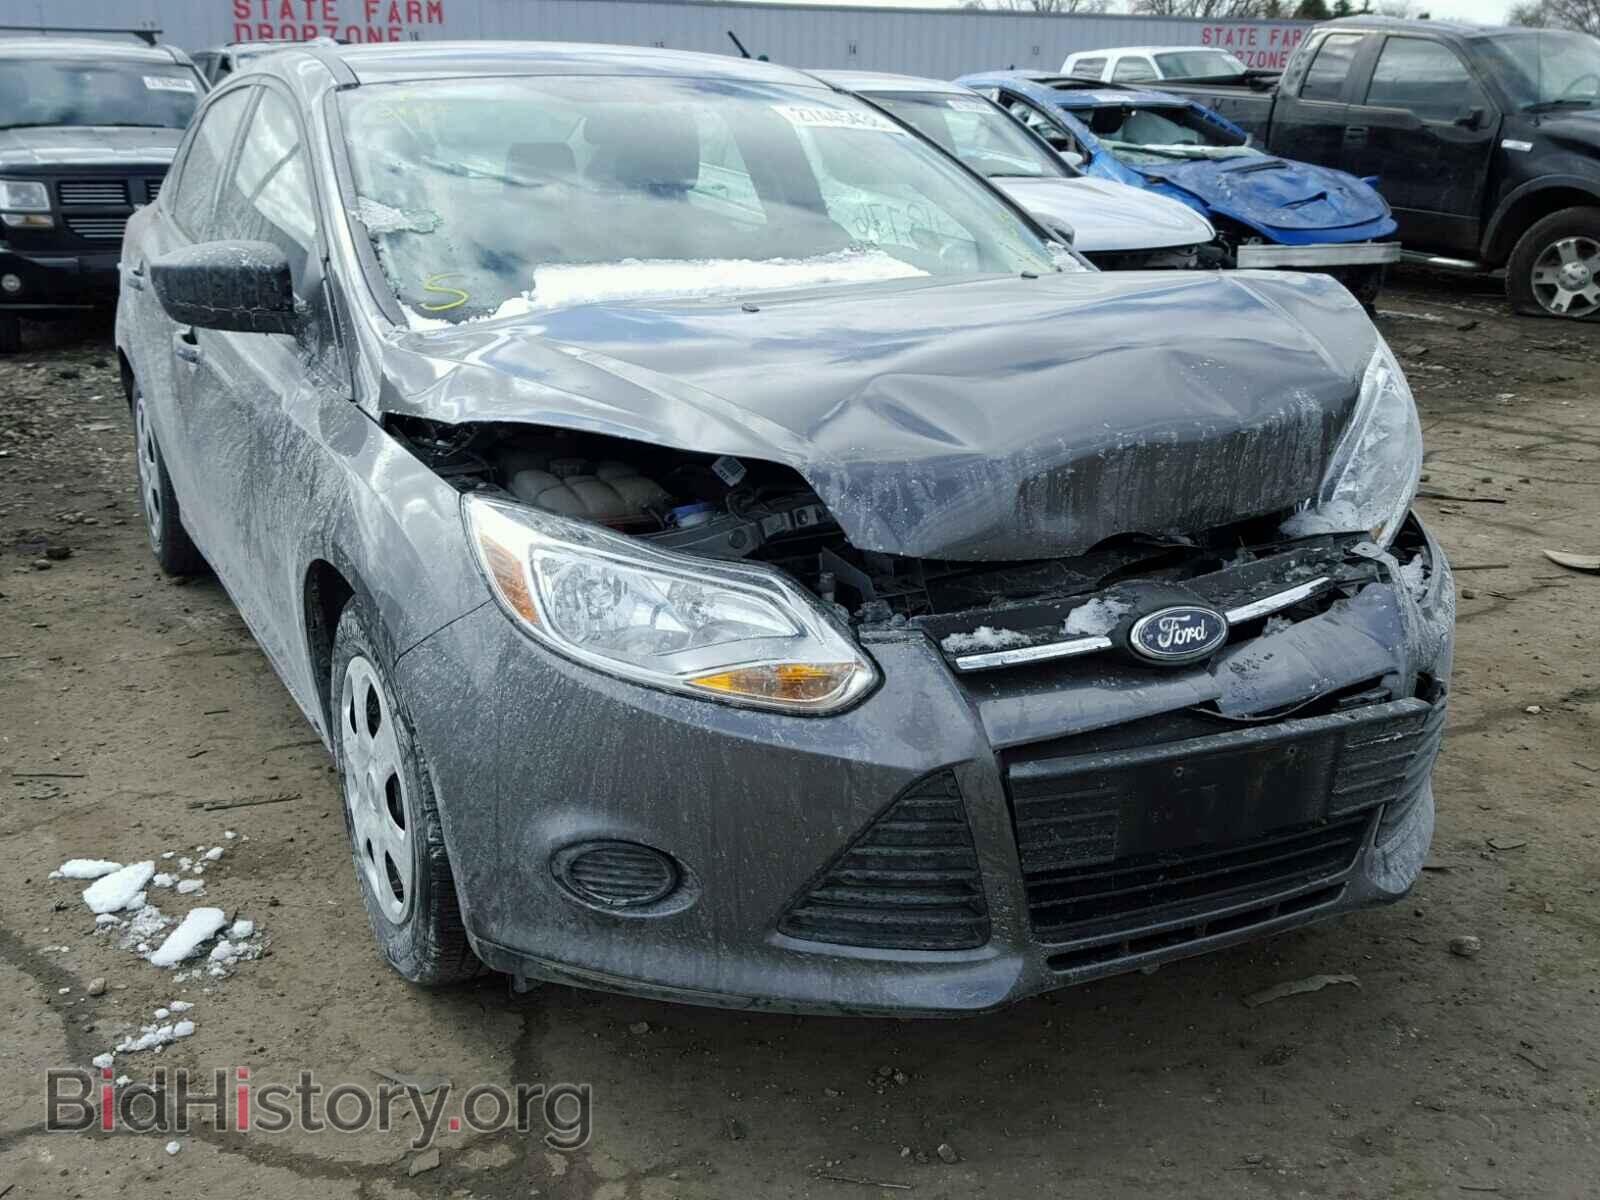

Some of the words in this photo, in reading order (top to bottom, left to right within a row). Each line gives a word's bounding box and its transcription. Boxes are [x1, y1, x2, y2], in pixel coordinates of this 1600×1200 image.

[233, 0, 340, 21] STATE
[365, 0, 443, 24] FARM
[1202, 28, 1257, 46] STATE
[1158, 615, 1207, 648] Ford
